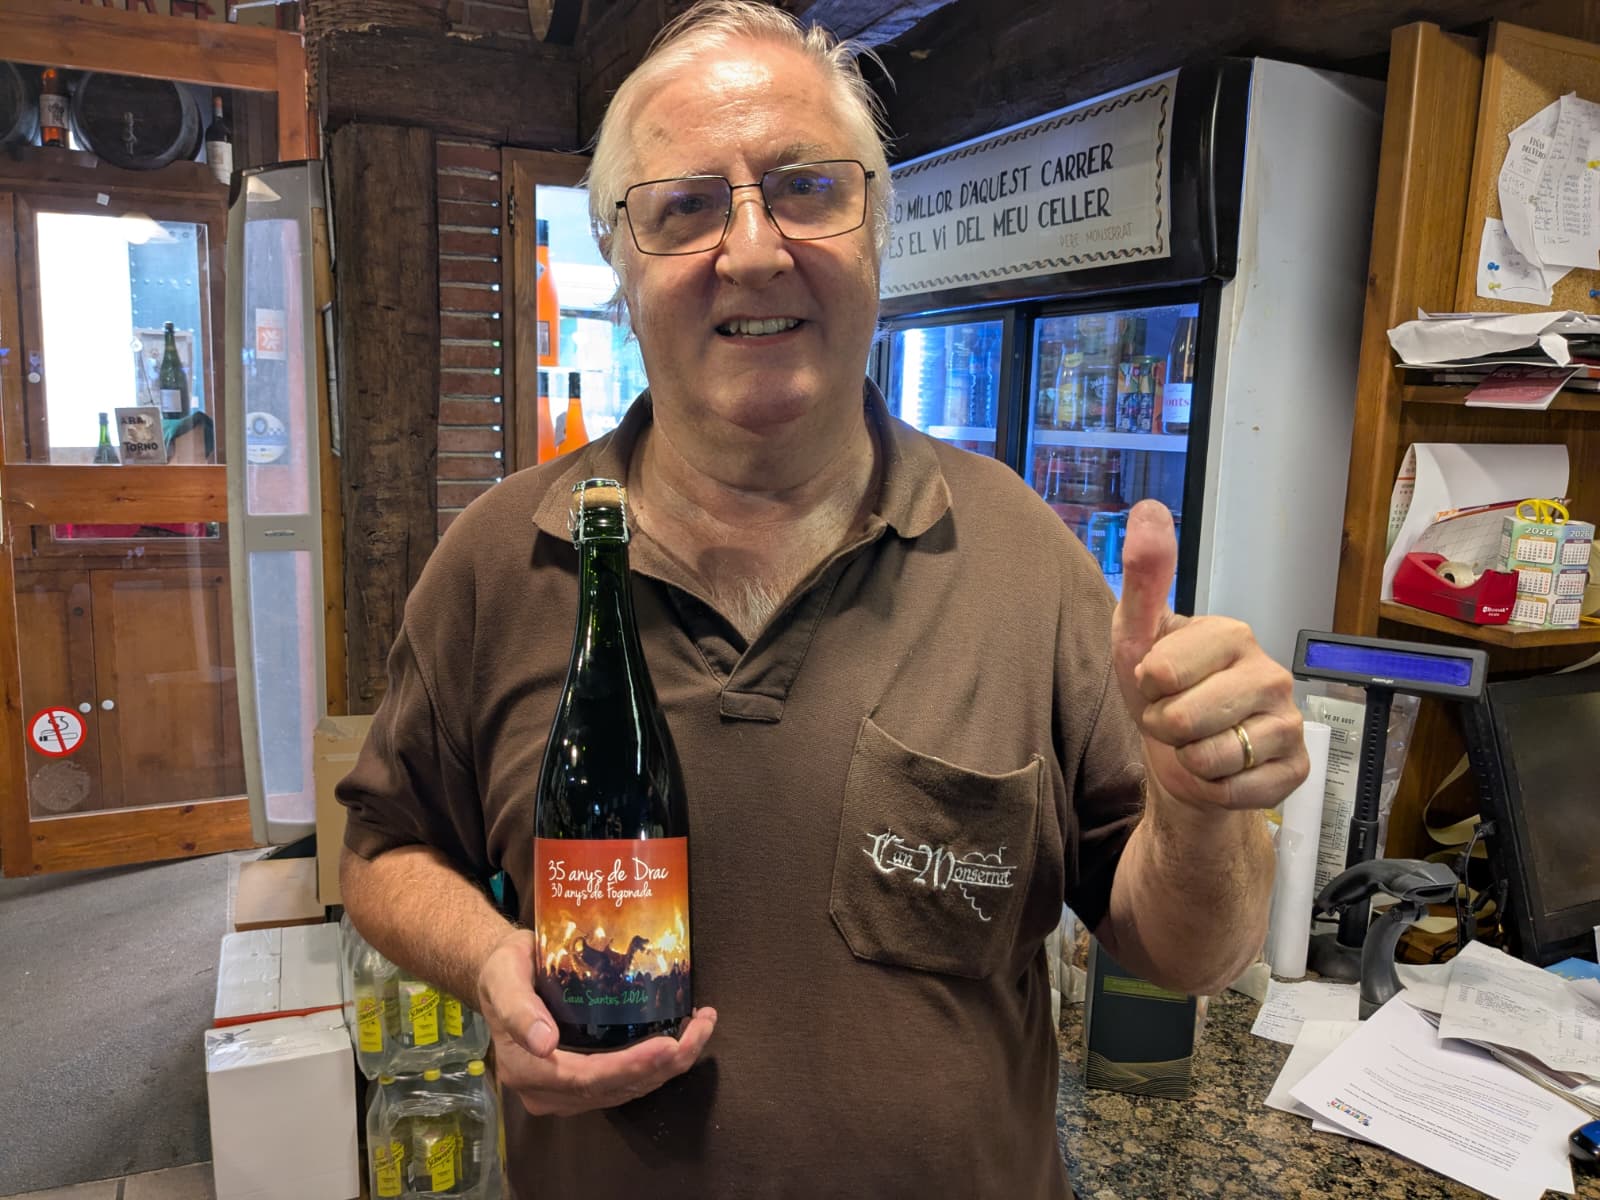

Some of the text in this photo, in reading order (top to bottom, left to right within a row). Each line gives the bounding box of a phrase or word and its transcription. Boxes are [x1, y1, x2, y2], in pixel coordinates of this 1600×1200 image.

[960, 165, 1031, 209] D'AQUEST
[1041, 142, 1114, 187] CARRER
[909, 231, 927, 256] EL
[956, 216, 985, 246] DEL
[993, 205, 1028, 238] MEU
[1038, 187, 1112, 229] CELLER
[123, 442, 158, 452] TORNO
[1525, 527, 1553, 537] 2026
[548, 856, 669, 893] 35 anys de Drac
[551, 880, 653, 908] 30 anys de Fogonada
